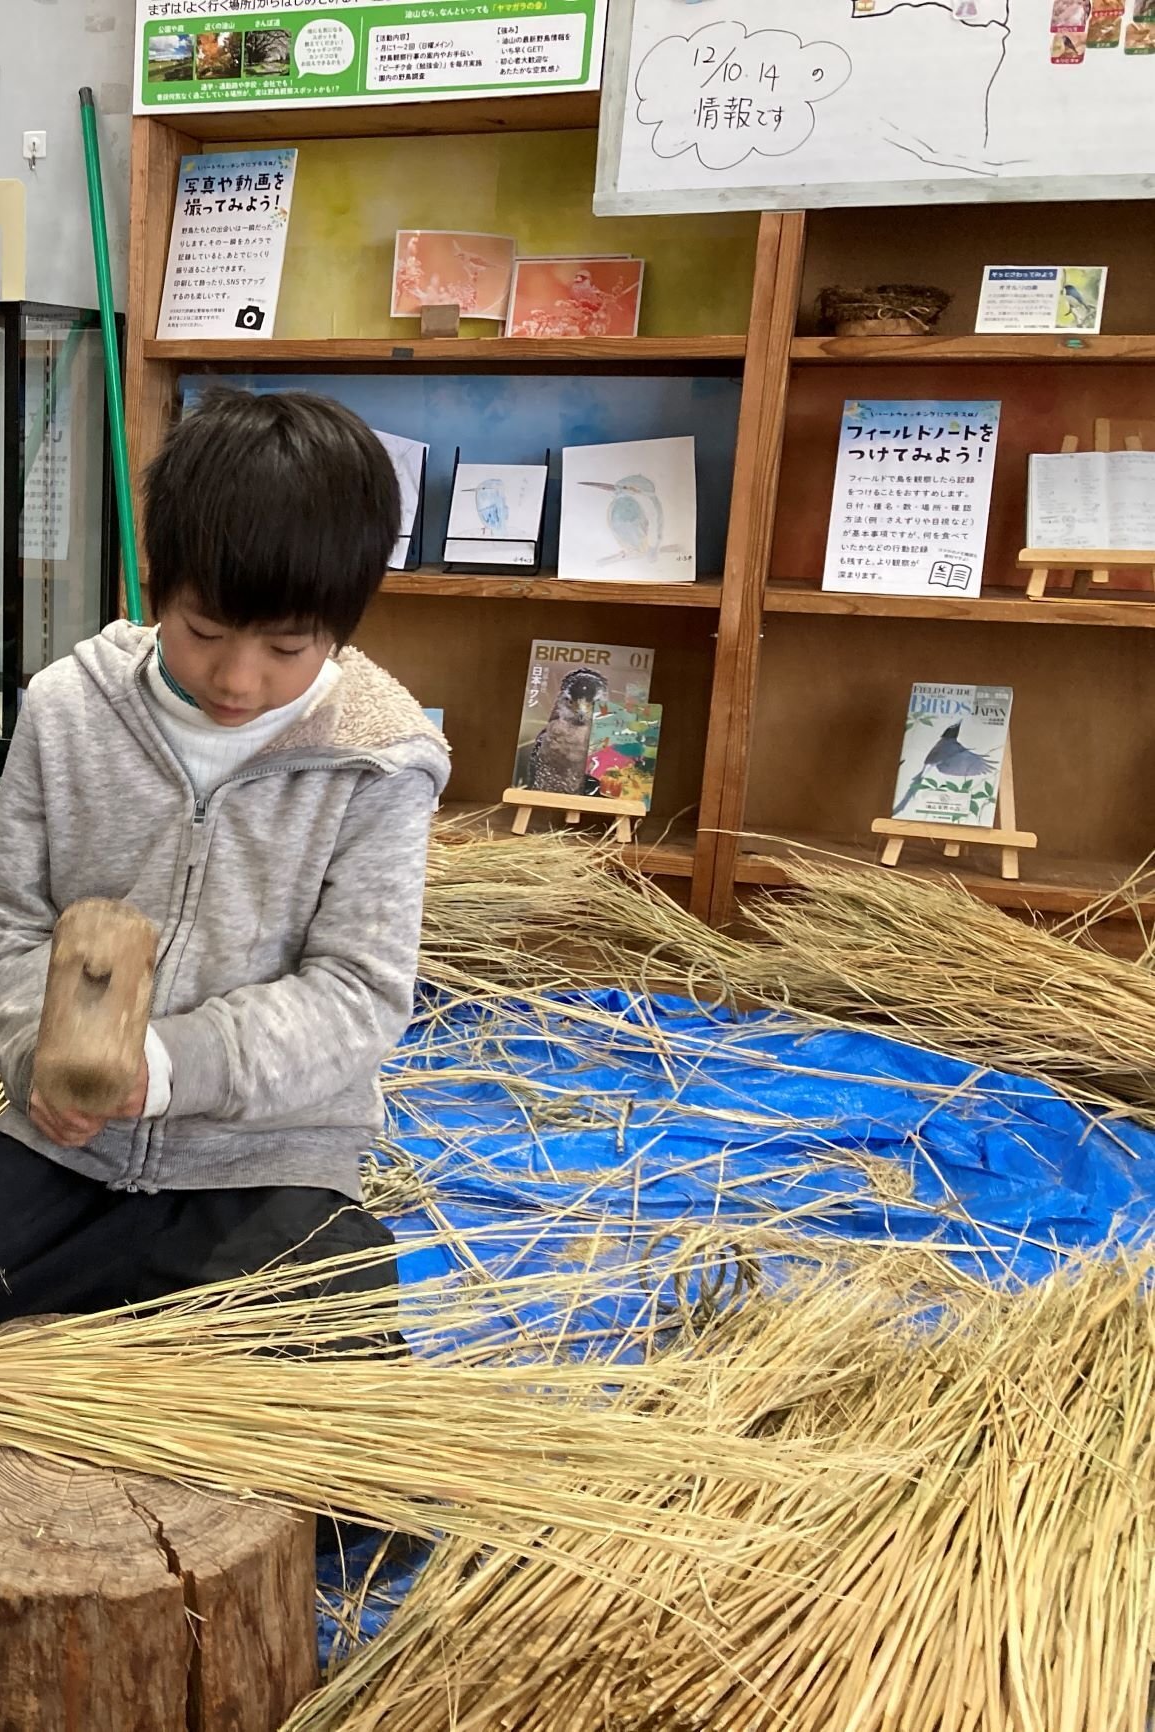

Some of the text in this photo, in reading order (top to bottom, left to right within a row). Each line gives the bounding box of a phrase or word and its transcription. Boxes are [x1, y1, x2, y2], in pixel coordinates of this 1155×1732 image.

[693, 96, 784, 132] 情報です
[184, 171, 285, 195] 写真や動画を
[184, 194, 280, 216] 撮ってみよう!
[847, 423, 994, 443] フィールドノートを
[848, 446, 984, 464] つけてみよう!
[849, 475, 975, 484] フィールドで鳥を観察したら記録
[848, 488, 970, 498] をつけることをおすすめします。
[841, 543, 929, 553] いたかなどの行動記録
[534, 645, 612, 666] BIRDER
[913, 685, 941, 694] FIELD
[910, 695, 971, 715] BIRDS
[972, 704, 1006, 716] JAPAN
